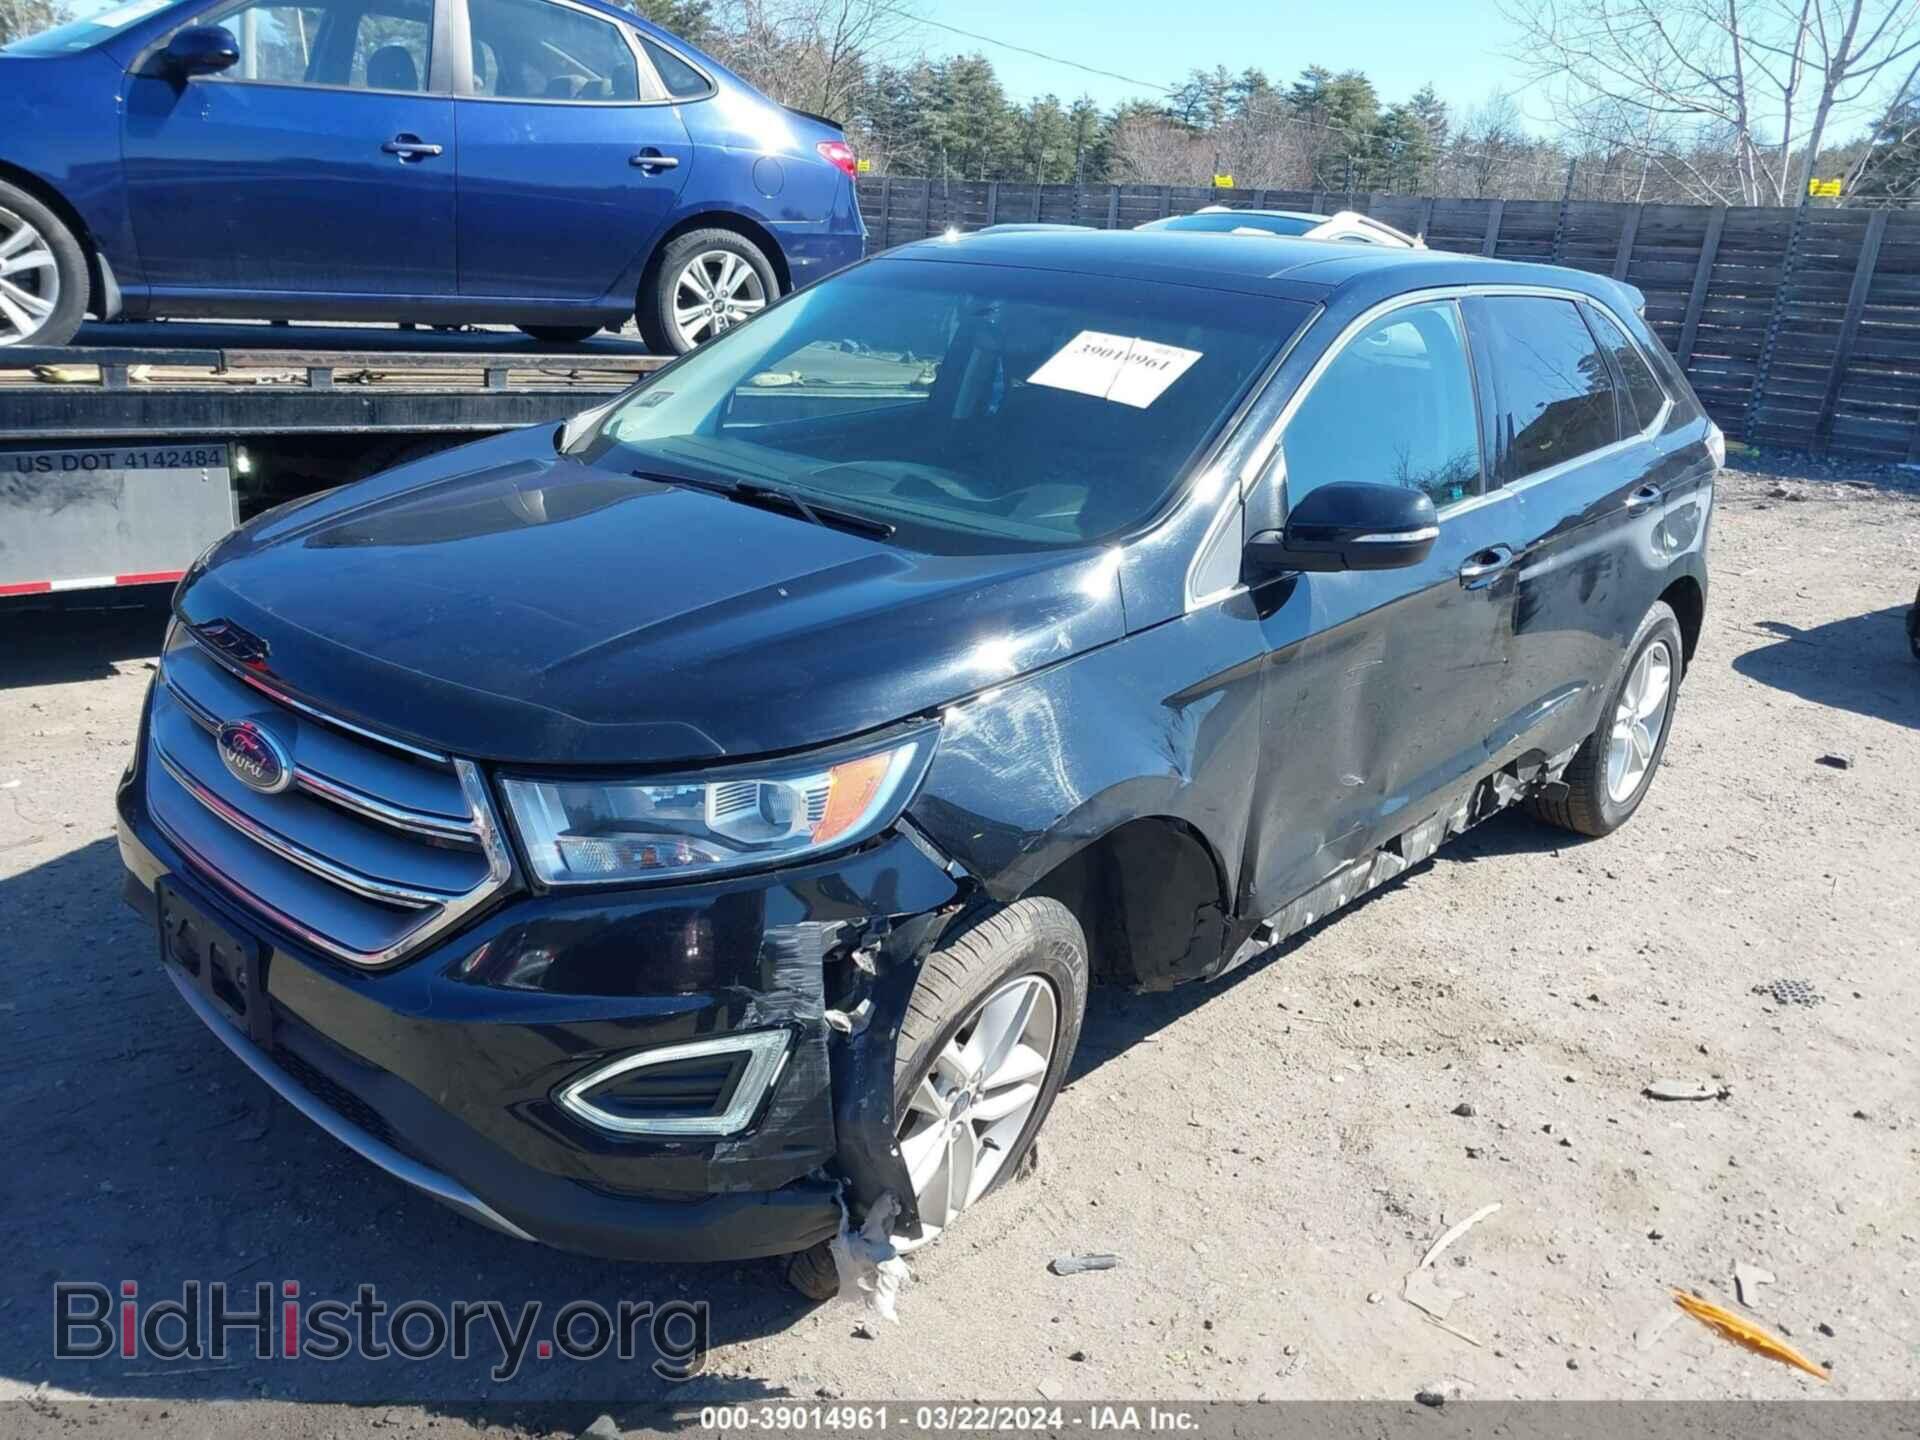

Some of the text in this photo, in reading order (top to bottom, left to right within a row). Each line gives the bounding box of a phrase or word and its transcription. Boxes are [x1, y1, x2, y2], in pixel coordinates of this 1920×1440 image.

[16, 450, 221, 473] US DOT 4142484
